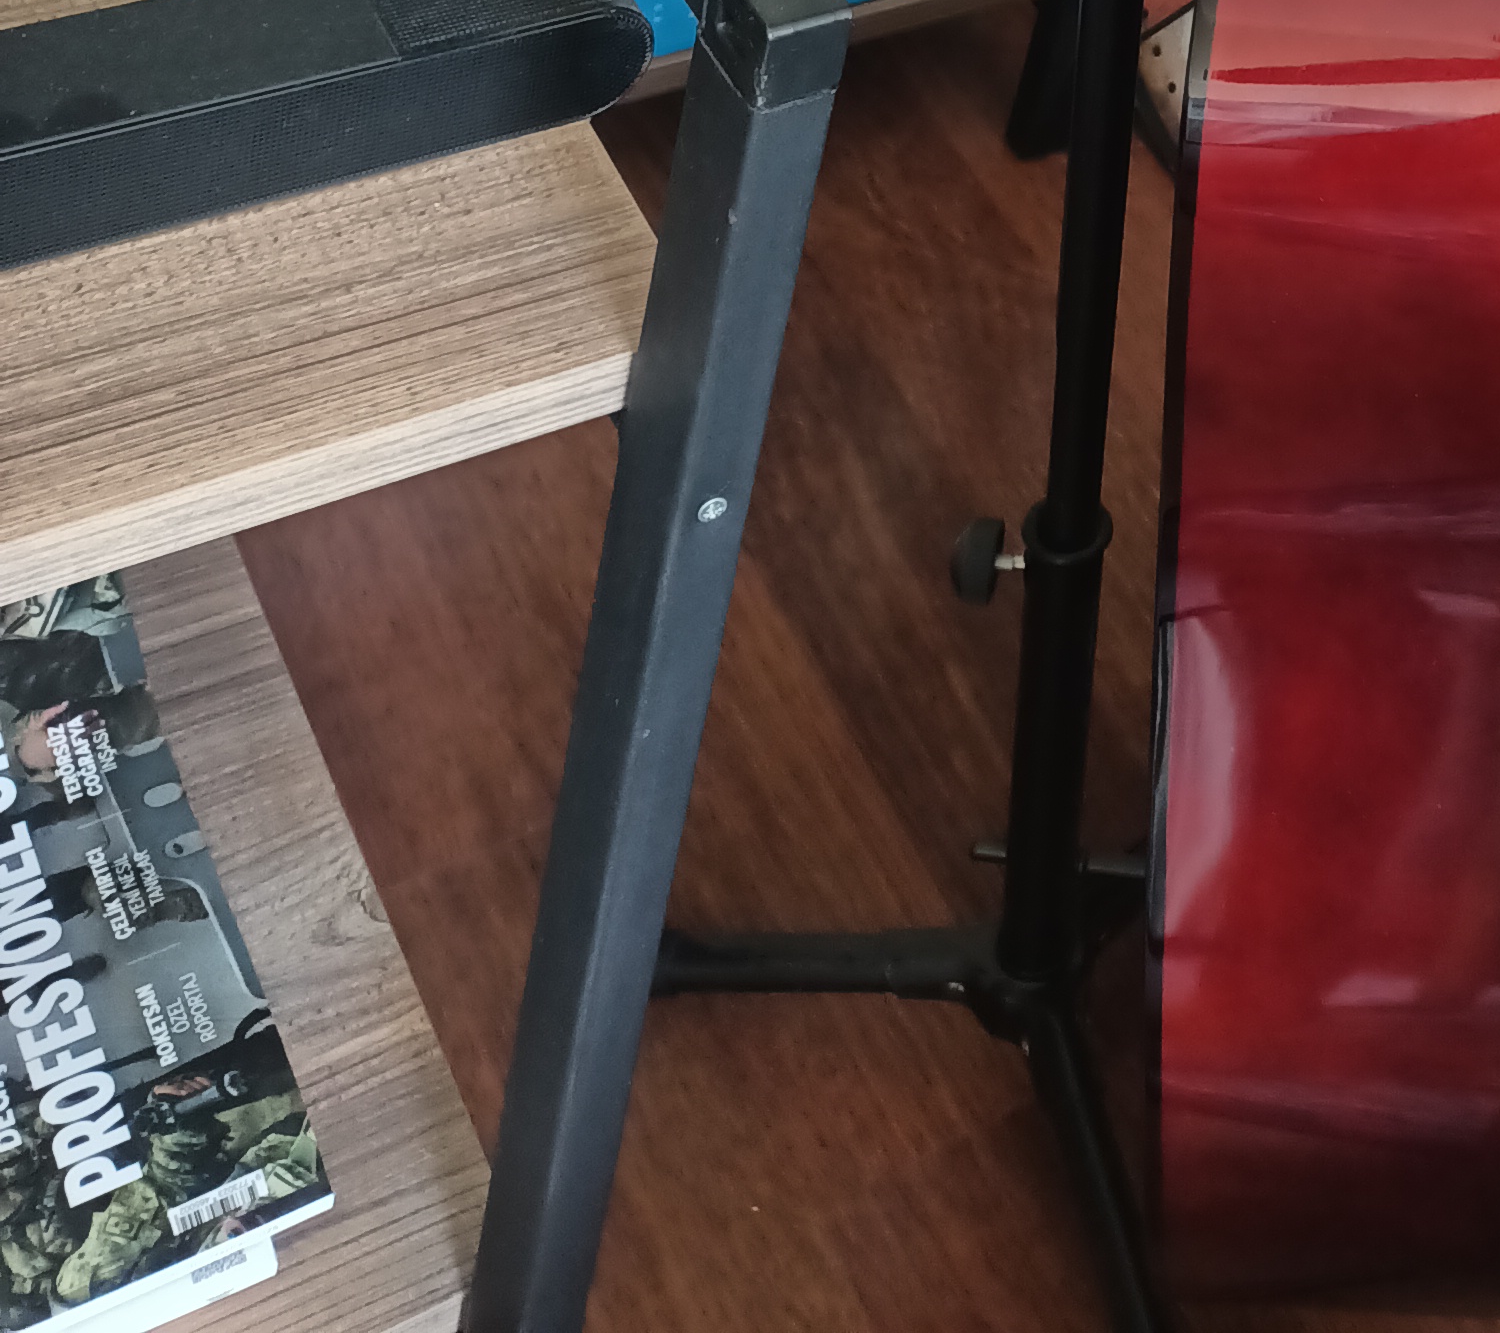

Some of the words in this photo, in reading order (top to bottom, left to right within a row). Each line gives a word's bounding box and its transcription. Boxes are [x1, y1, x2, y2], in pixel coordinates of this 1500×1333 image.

[46, 722, 84, 805] TERÖRSÜZ
[66, 713, 105, 798] COĞRAFYA
[133, 847, 165, 908] TANKLAR
[134, 982, 180, 1068] ROKETSAN
[165, 996, 192, 1035] ÖZEL
[178, 971, 219, 1044] RÖPORTAJ
